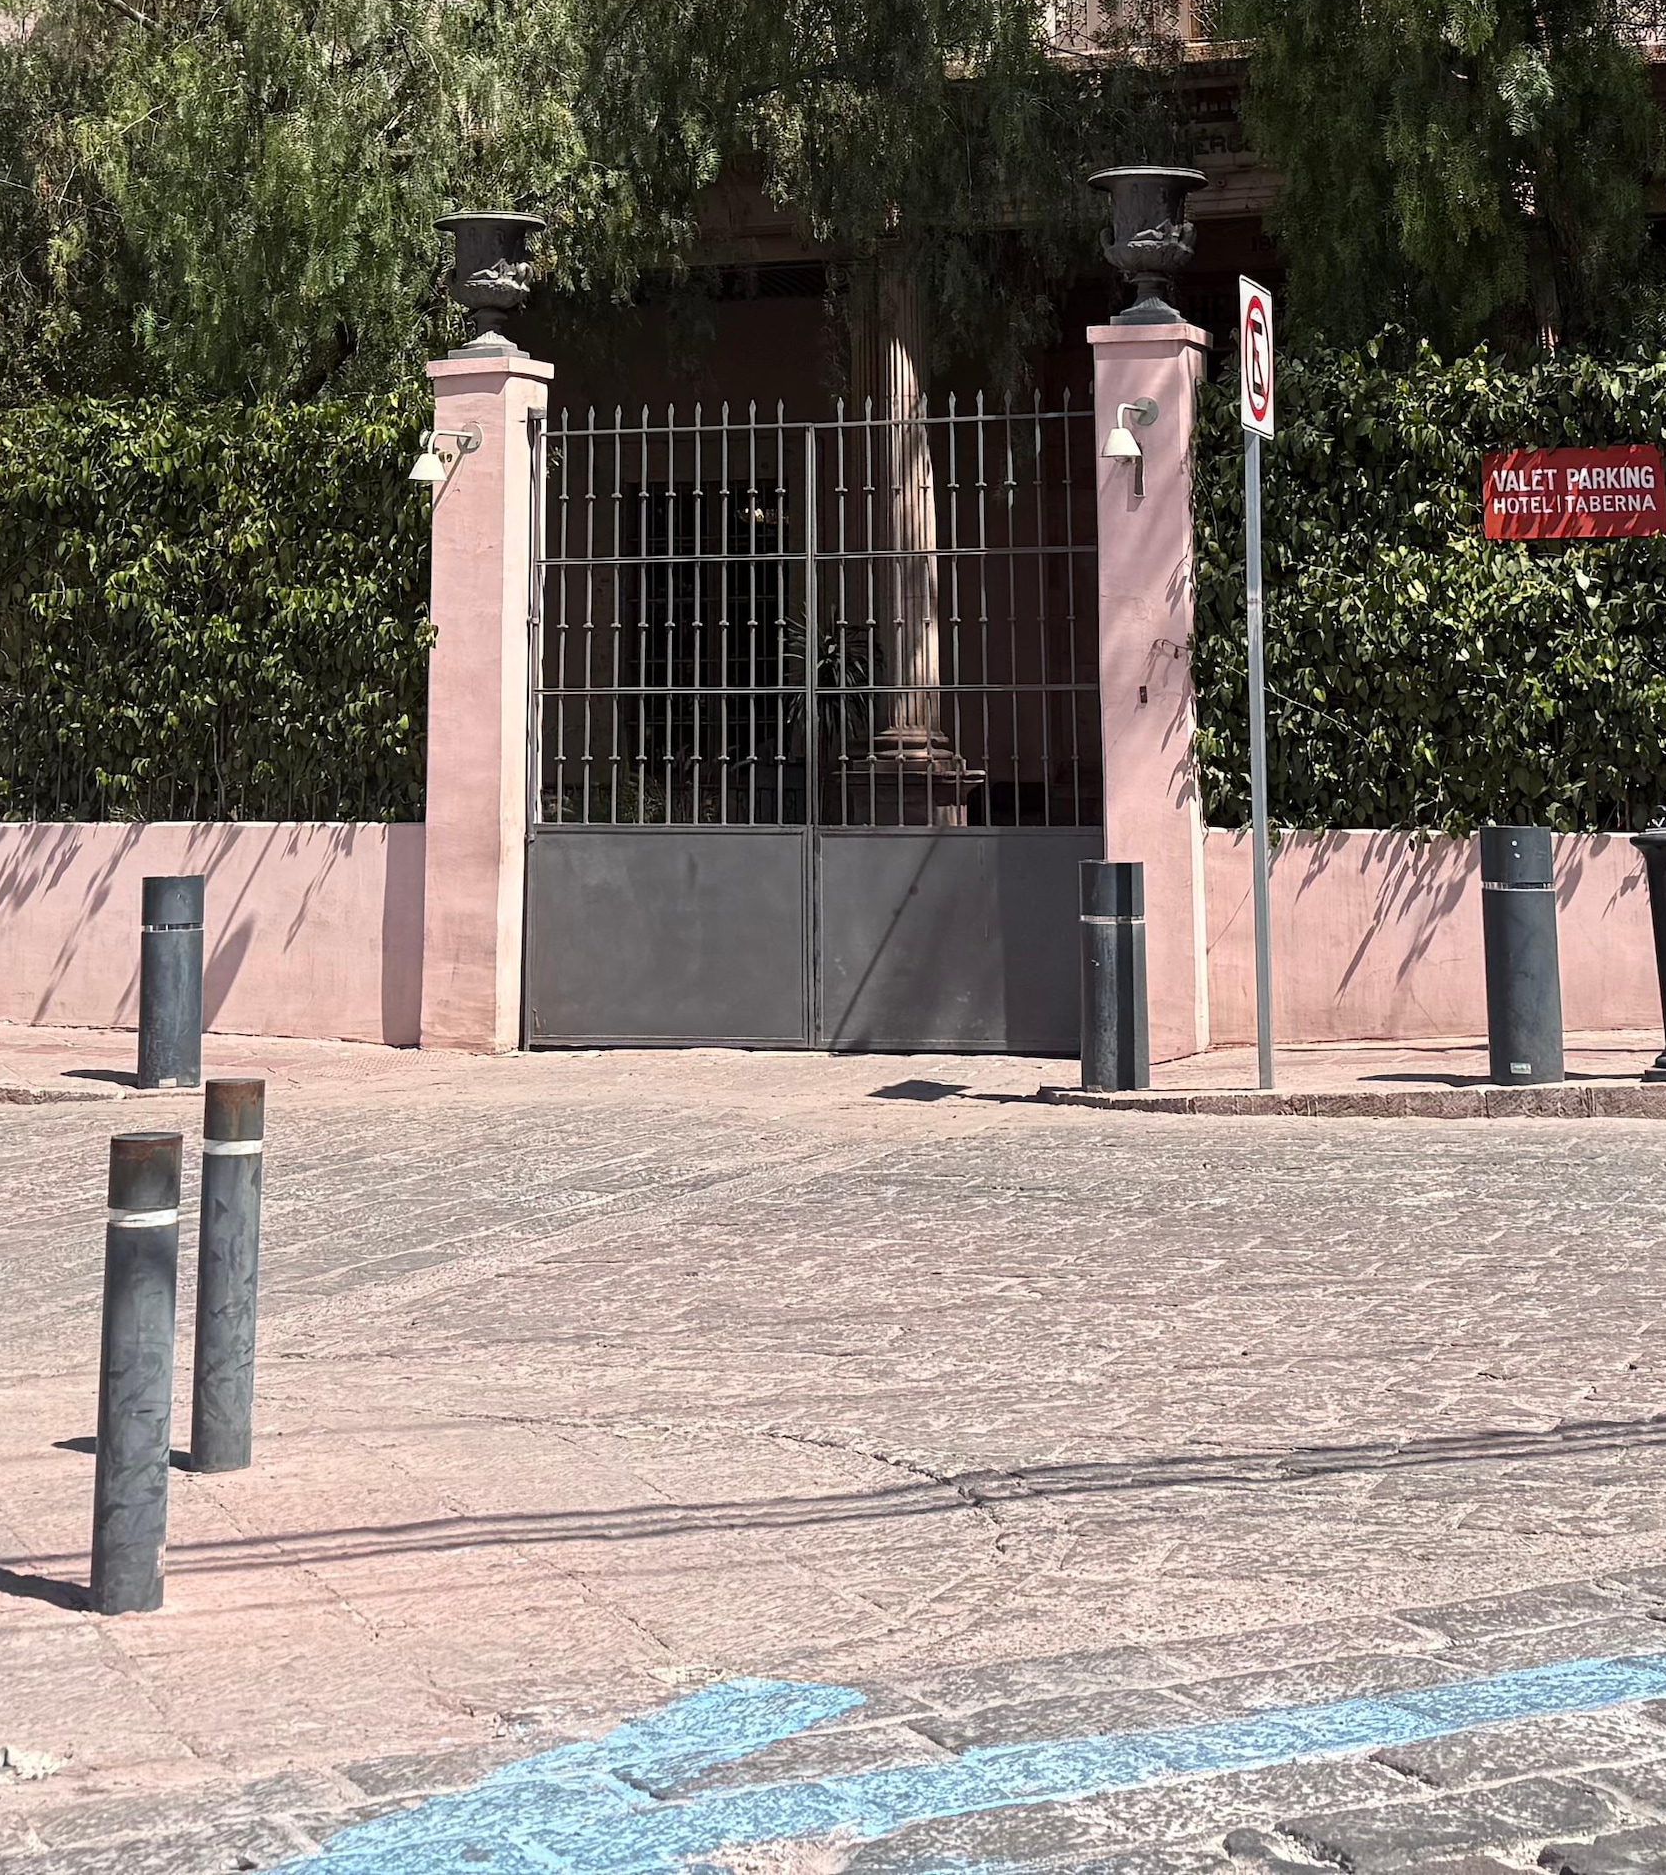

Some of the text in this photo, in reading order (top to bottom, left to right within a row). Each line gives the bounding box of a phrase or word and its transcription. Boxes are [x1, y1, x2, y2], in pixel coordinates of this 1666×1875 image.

[1492, 465, 1655, 492] VALET PARKING
[1493, 496, 1553, 514] HOTEL
[1565, 494, 1657, 513] TABERNA
